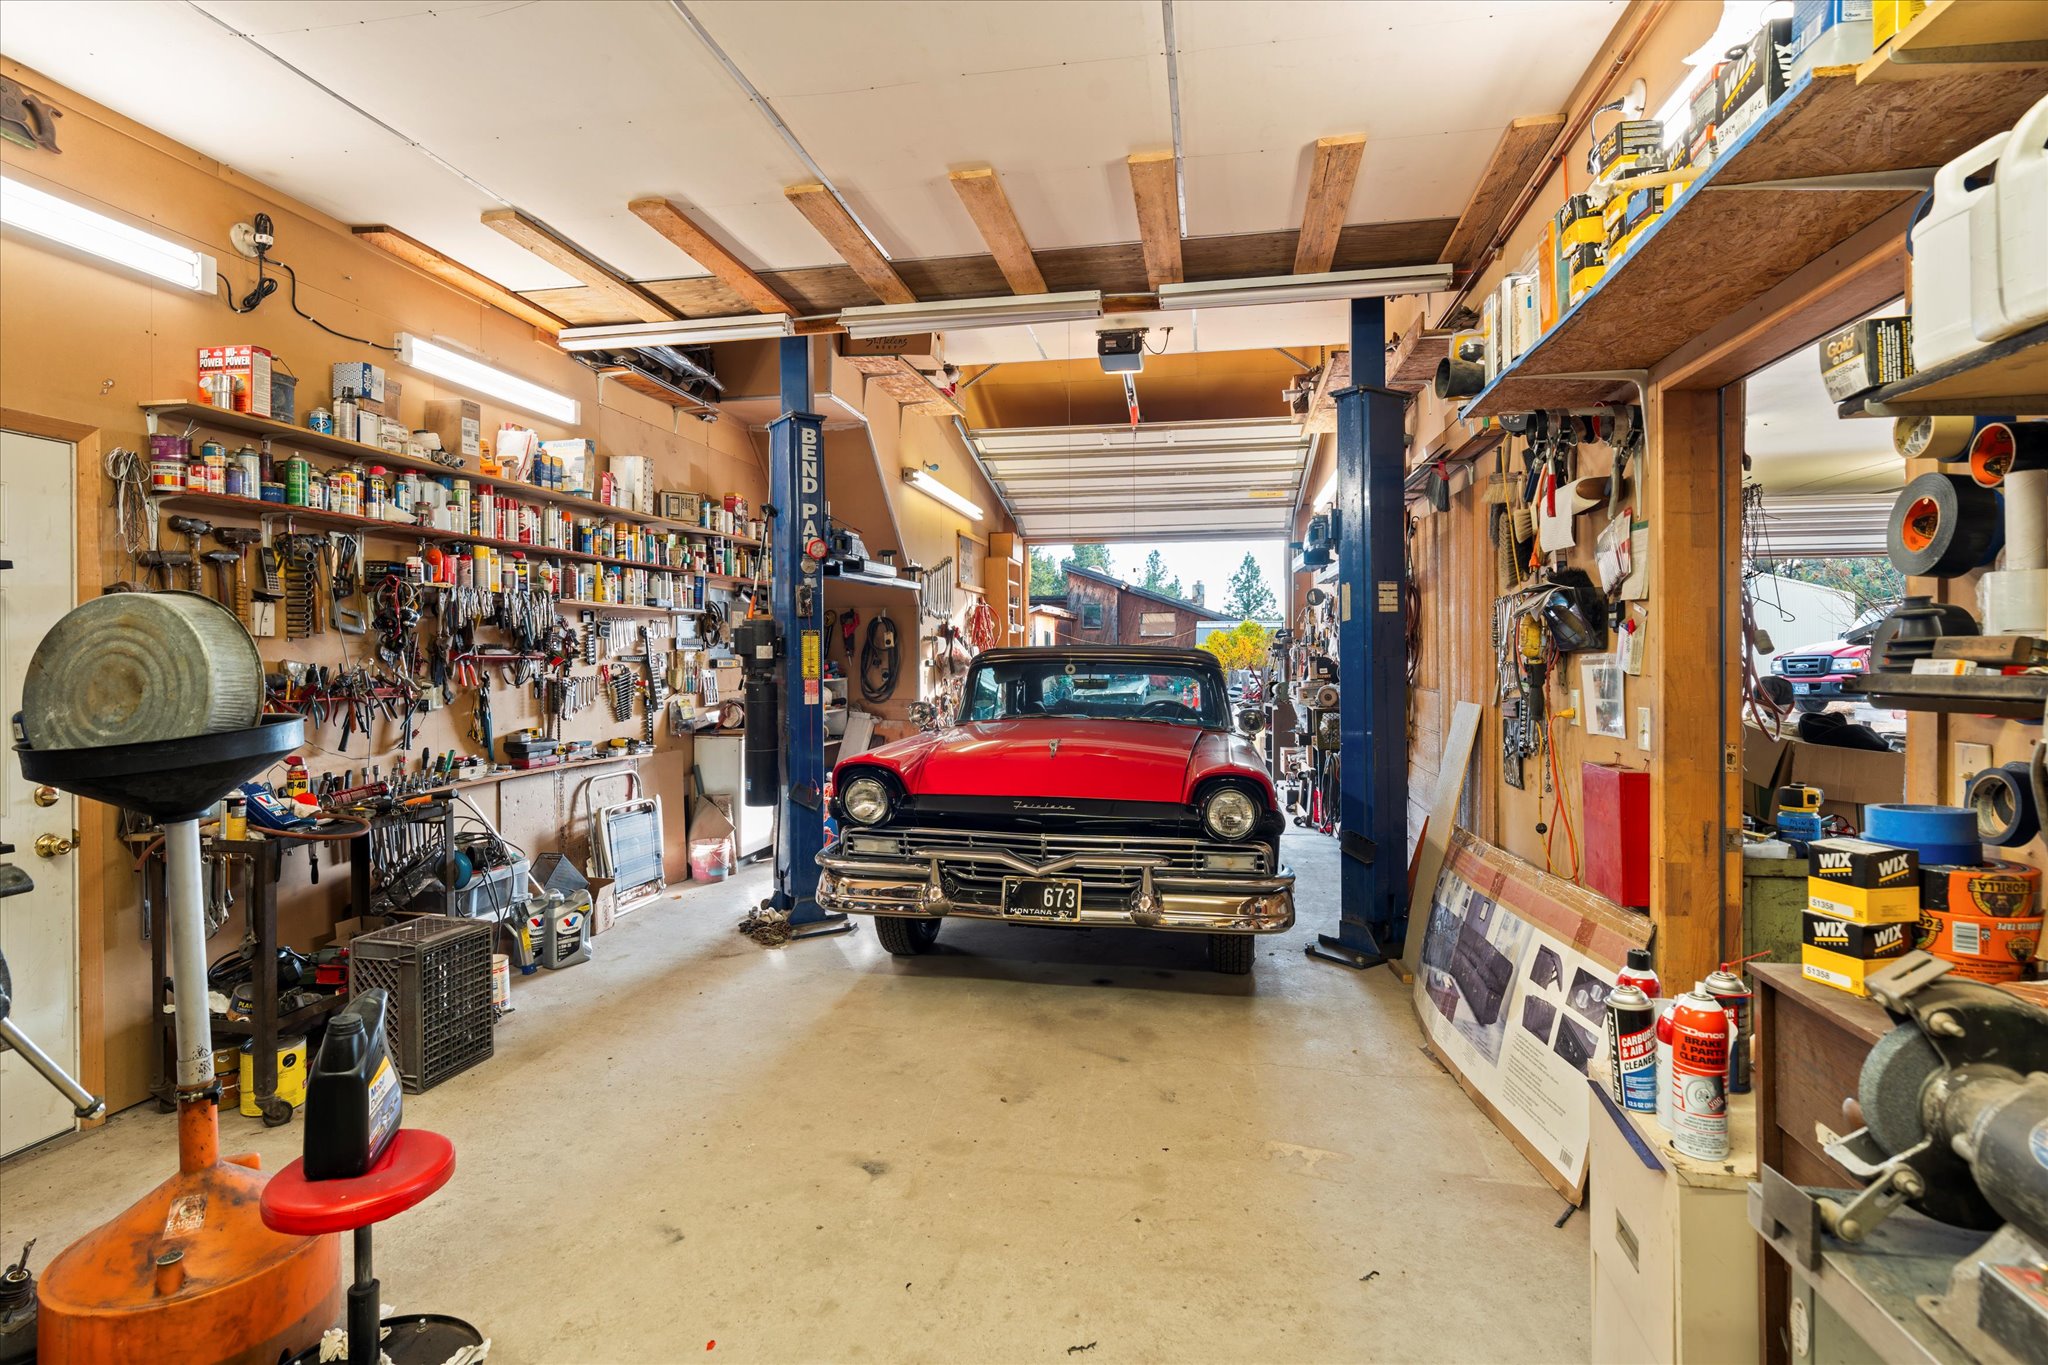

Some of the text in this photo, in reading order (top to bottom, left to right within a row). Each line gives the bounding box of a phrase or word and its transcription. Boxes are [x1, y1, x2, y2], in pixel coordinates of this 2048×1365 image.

[224, 347, 238, 357] NU-
[1827, 332, 1856, 358] Gold
[199, 358, 224, 368] POWER
[225, 356, 250, 366] POWER
[801, 427, 818, 493] BEND
[1818, 852, 1853, 868] WIX
[1878, 853, 1910, 877] WIX
[1010, 884, 1019, 893] 7
[1978, 881, 2027, 893] GORILLA
[1043, 888, 1075, 908] 673
[1812, 898, 1835, 911] 51358
[1813, 921, 1849, 937] WIX
[1874, 924, 1904, 948] WIX
[1806, 966, 1830, 980] 51358
[1684, 1036, 1722, 1048] BRAKE
[1622, 1048, 1630, 1058] &
[1630, 1045, 1644, 1057] AIR
[1681, 1043, 1725, 1057] & PARTS
[1624, 1054, 1656, 1071] CLEANER
[1680, 1051, 1726, 1065] CLEANER
